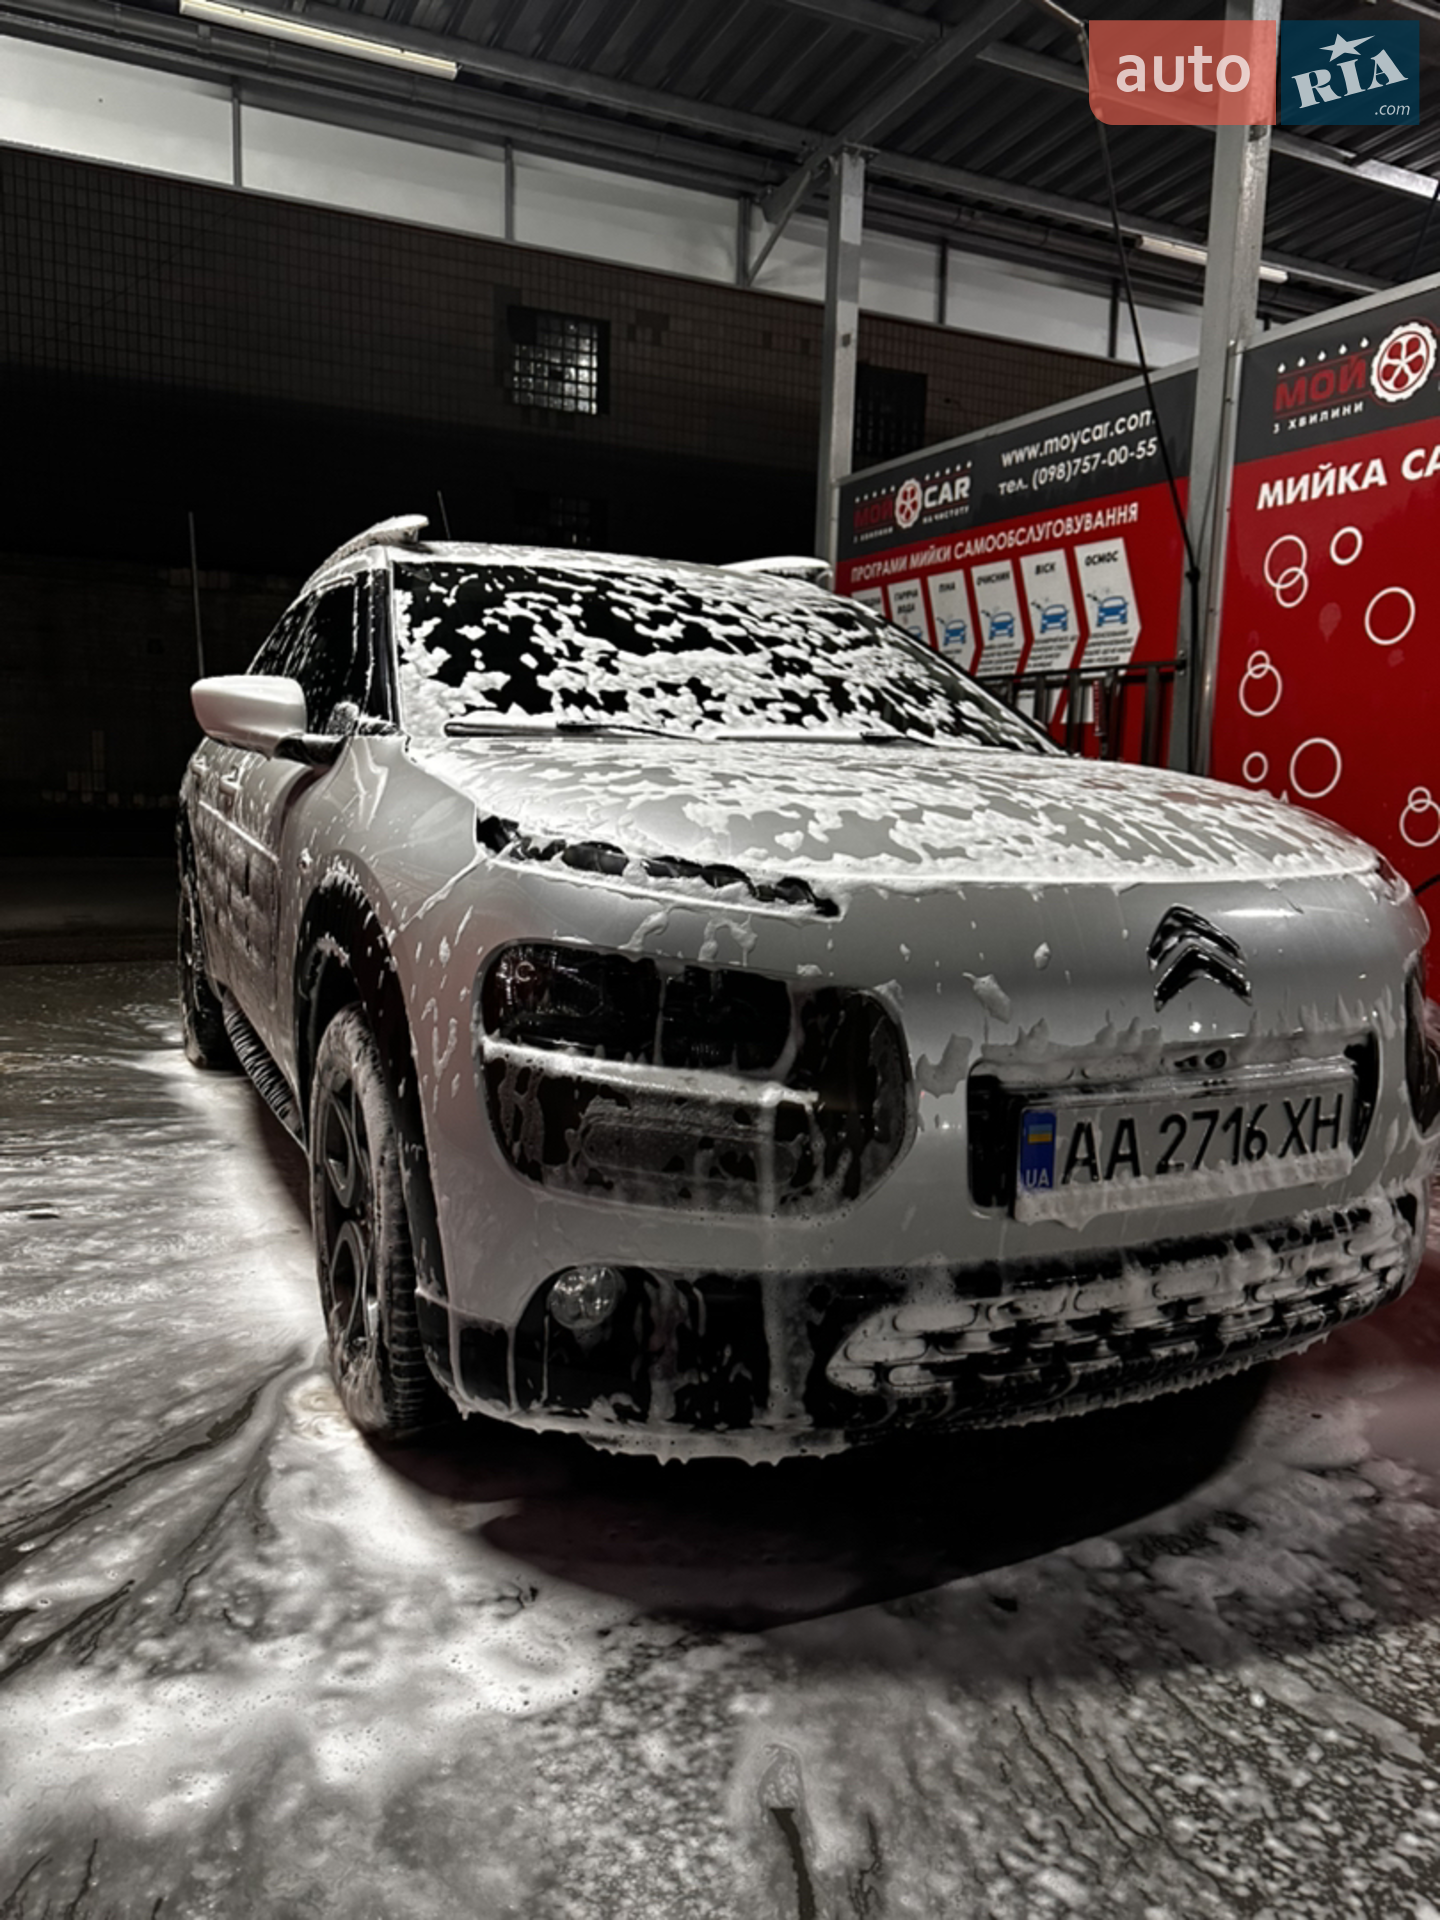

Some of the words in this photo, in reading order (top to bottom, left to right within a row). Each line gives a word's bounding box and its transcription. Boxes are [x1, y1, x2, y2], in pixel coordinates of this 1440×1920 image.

[1274, 355, 1367, 412] МОЙ
[1288, 402, 1364, 430] ХВИЛИНИ
[1032, 436, 1158, 491] (098)757-00-55
[1256, 458, 1388, 511] МИЙКА
[924, 476, 971, 508] CAR
[850, 554, 908, 583] ПРОГРАМИ
[909, 544, 951, 571] МИЙКИ
[954, 501, 1138, 560] САМООБСЛУГОВУВАННЯ
[1085, 550, 1119, 567] ОСМОС
[1035, 561, 1056, 576] ВІСК
[1155, 1103, 1269, 1175] 2716
[1025, 1168, 1051, 1188] UA
